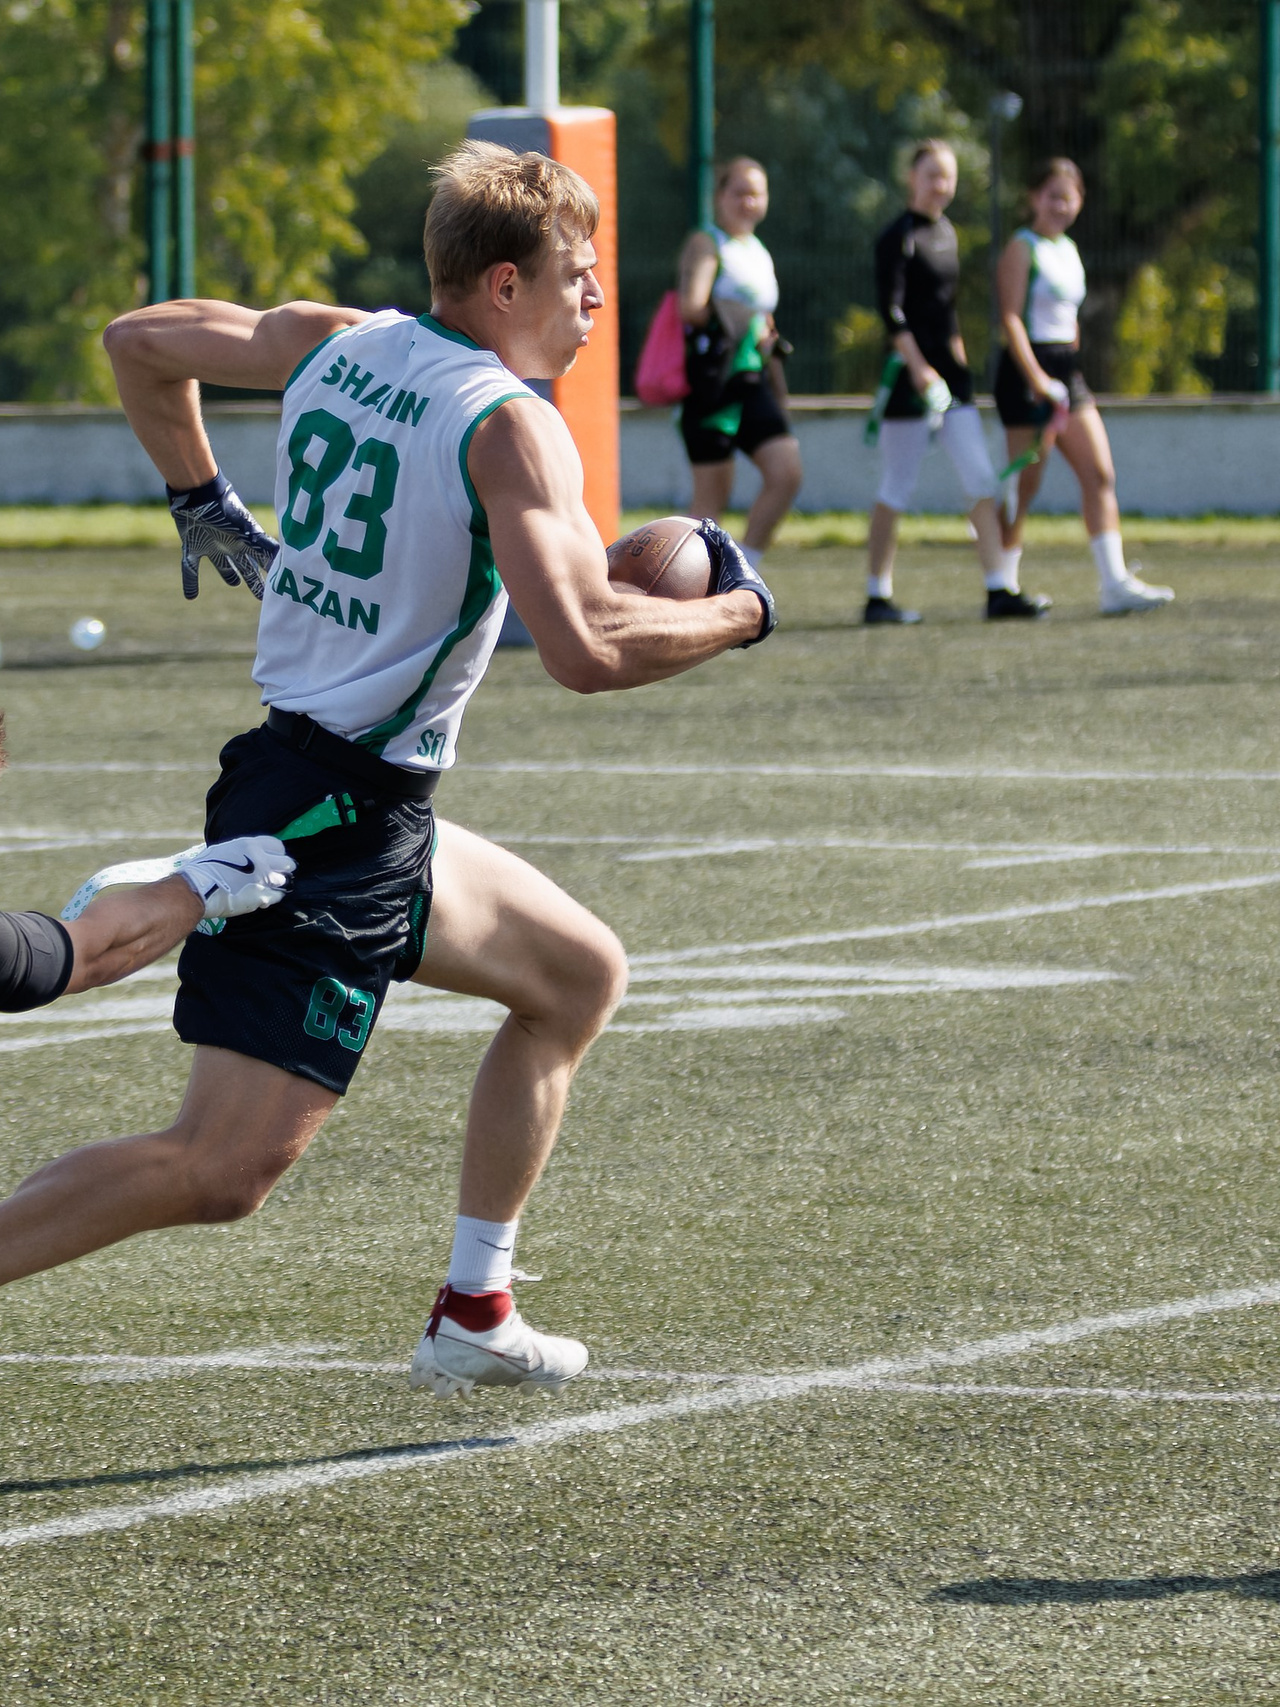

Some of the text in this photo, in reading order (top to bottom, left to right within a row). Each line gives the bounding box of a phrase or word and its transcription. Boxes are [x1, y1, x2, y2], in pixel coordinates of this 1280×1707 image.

[281, 407, 401, 581] 83
[269, 565, 381, 636] AZAN
[302, 976, 377, 1053] 83
